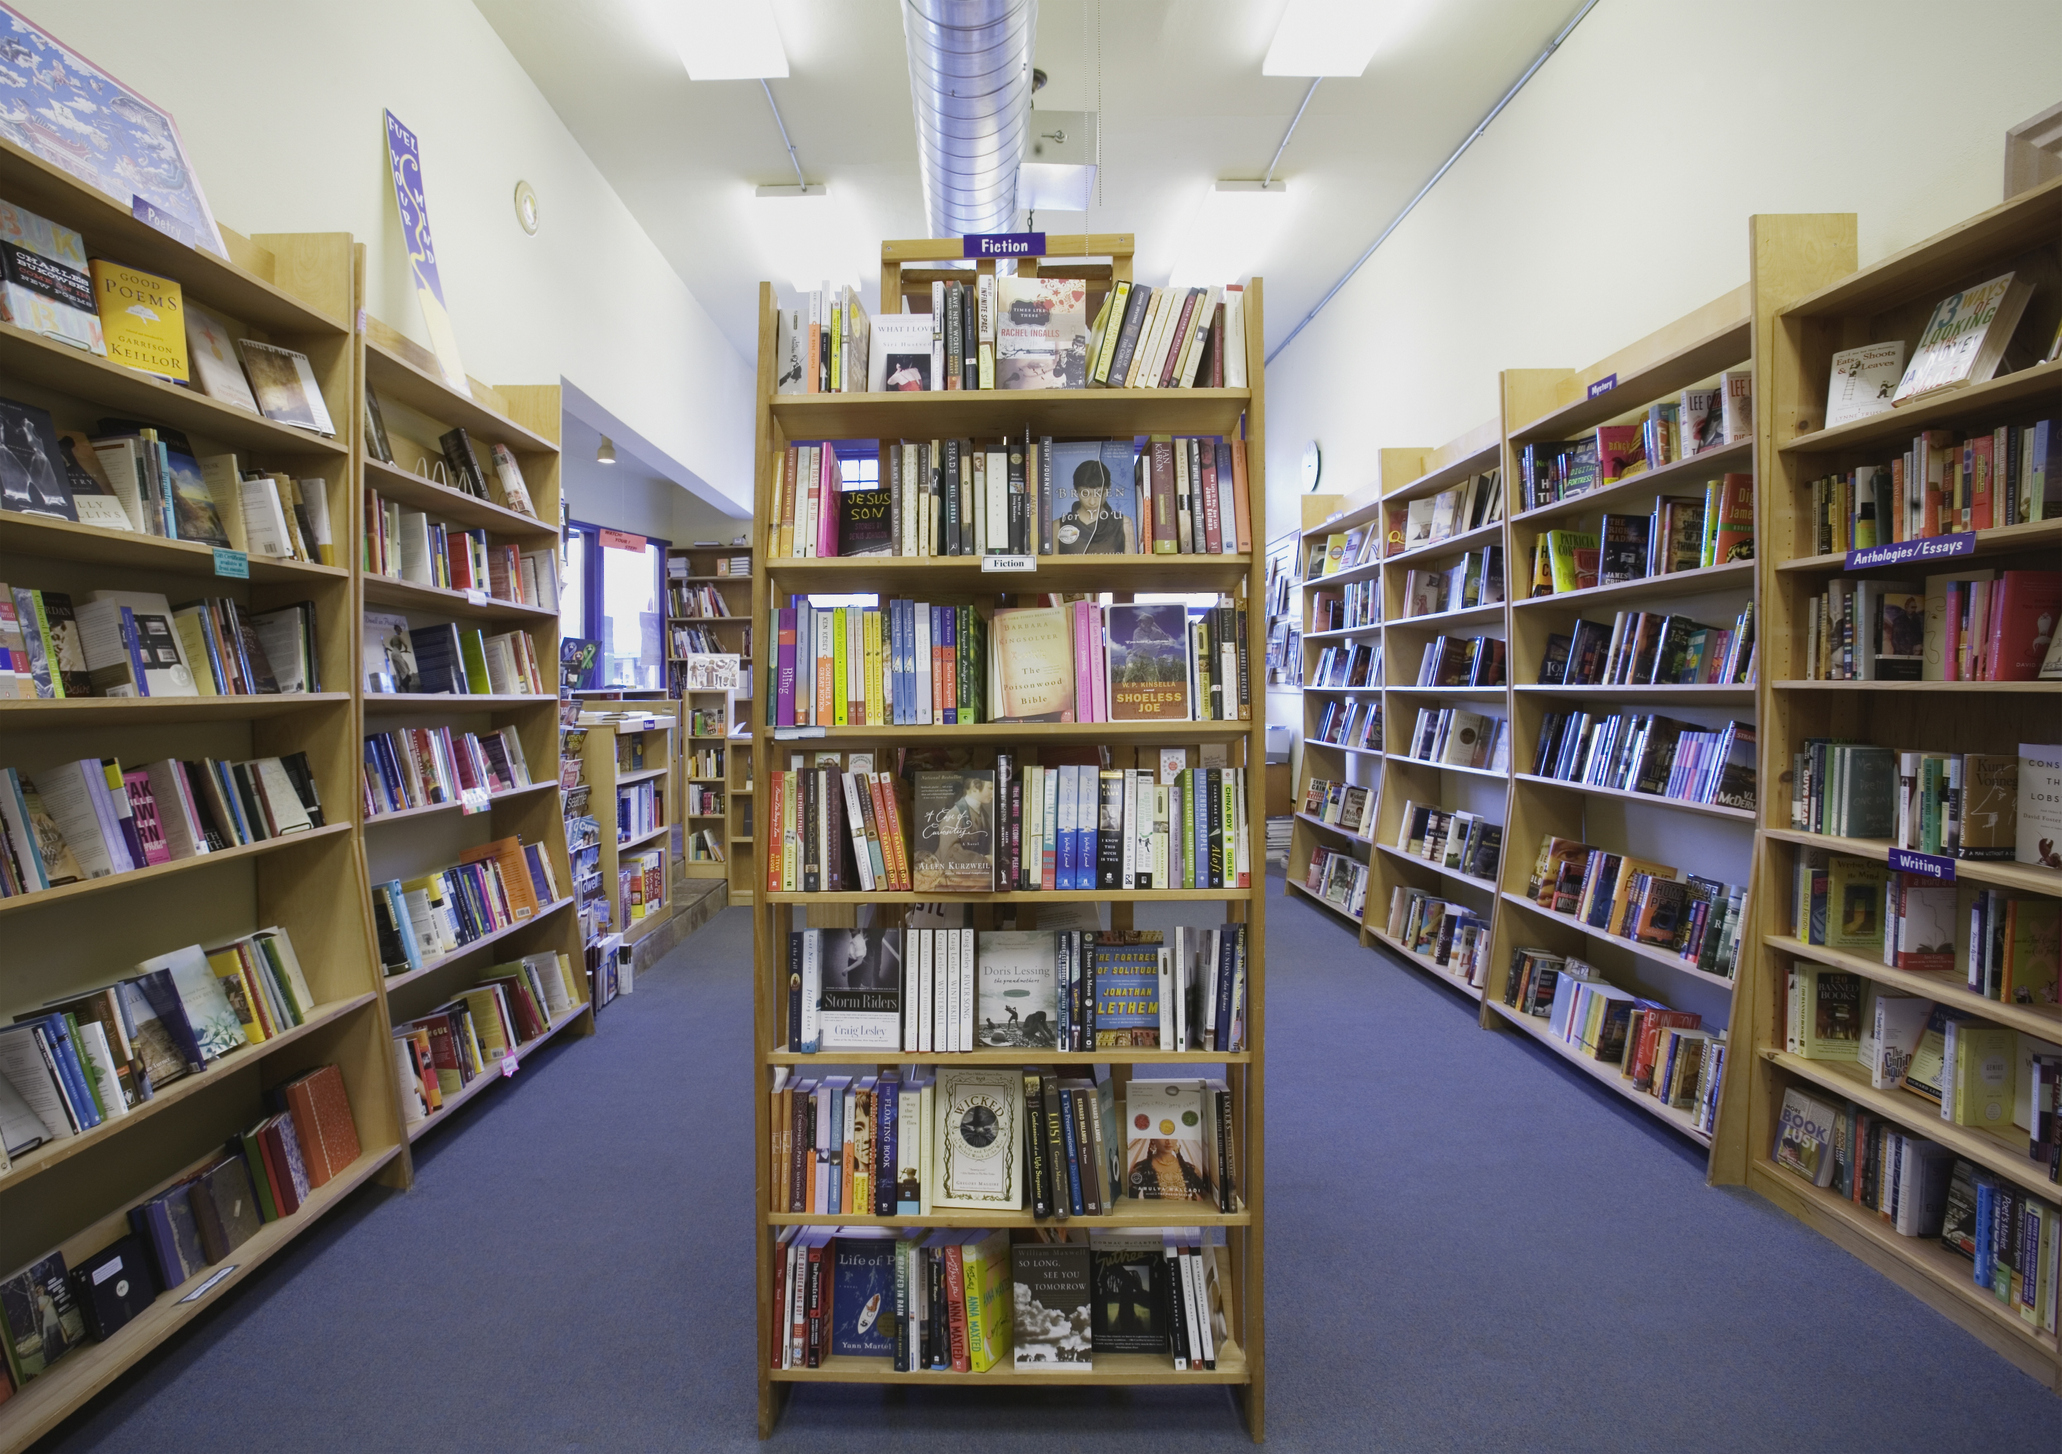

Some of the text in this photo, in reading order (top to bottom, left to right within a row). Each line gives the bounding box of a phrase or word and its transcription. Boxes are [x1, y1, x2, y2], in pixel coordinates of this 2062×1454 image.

[388, 116, 416, 153] FUEL
[392, 150, 412, 226] YOUR
[148, 207, 181, 239] Poetry
[414, 188, 434, 264] MIND
[982, 239, 1028, 252] Fiction
[16, 252, 89, 286] CHARLES
[17, 259, 90, 294] BUKOWSKI
[19, 268, 52, 284] COME
[56, 281, 72, 292] ON
[120, 273, 160, 290] GOOD
[20, 274, 92, 307] NEW POEMS
[105, 278, 177, 311] POEMS
[1926, 278, 2009, 335] 13 WAYS
[1974, 298, 1994, 315] OF
[1001, 329, 1059, 337] RACHEL INGALLS
[1921, 307, 1997, 348] LOOKING
[118, 336, 172, 354] GARRISON
[243, 340, 266, 351] SCHOOL
[111, 343, 182, 370] KEILLOR
[1863, 350, 1896, 360] Shoots
[1837, 360, 1894, 375] & Leaves
[1592, 380, 1612, 395] Mystery
[1731, 380, 1745, 397] LEE
[1689, 396, 1703, 411] LEE
[1835, 414, 1858, 422] LYNNE
[1155, 443, 1163, 472] KARON
[1162, 449, 1170, 464] JAN
[1570, 465, 1596, 476] DIGITAL
[1568, 475, 1593, 486] FORTRESS
[848, 492, 891, 504] JESUS
[1056, 488, 1125, 499] BROKEN
[852, 507, 884, 520] SON
[1061, 510, 1123, 523] for YOU
[1610, 518, 1625, 526] THE
[1560, 533, 1595, 548] PATRICIA
[1608, 535, 1647, 543] MADNESS
[1854, 541, 1962, 565] Anthologies/Essays
[1004, 621, 1049, 631] BARBARA
[998, 633, 1059, 646] KINGSOLVER
[1022, 667, 1040, 675] The
[779, 667, 793, 694] Bling
[1004, 679, 1063, 691] Poisonwood
[1021, 695, 1047, 705] Bible
[1116, 692, 1182, 703] SHOELESS
[1138, 703, 1161, 713] JOE
[1976, 759, 2005, 773] Kurt
[567, 792, 588, 809] Seattle
[919, 861, 990, 870] ALLEN KURZWEIL
[1212, 844, 1220, 873] Aloft
[1900, 855, 1941, 877] Writing
[583, 877, 598, 894] dwell
[984, 966, 1050, 977] Doris Lessing
[1097, 966, 1157, 975] OF SOLITUDE
[1830, 975, 1848, 983] 120
[1103, 988, 1153, 997] JONATHAN
[1818, 983, 1859, 992] BANNED
[825, 994, 897, 1008] Storm Riders
[1820, 991, 1856, 1000] BOOKS
[1098, 1002, 1158, 1015] LETHEM
[834, 1024, 887, 1039] Craig Lesley
[1885, 1046, 1903, 1056] The
[1908, 1078, 1929, 1092] RICHARD
[954, 1095, 1005, 1119] WICKED
[1785, 1104, 1801, 1114] MORE
[1048, 1112, 1061, 1146] LOST
[1782, 1109, 1827, 1141] BOOK
[1785, 1125, 1819, 1152] LUST
[2000, 1195, 2011, 1249] Poet's Market
[839, 1254, 895, 1266] Life of P
[1044, 1271, 1080, 1279] SEE YOU
[949, 1300, 963, 1360] ANNA MAXTED
[968, 1296, 981, 1352] ANNA MAXTED
